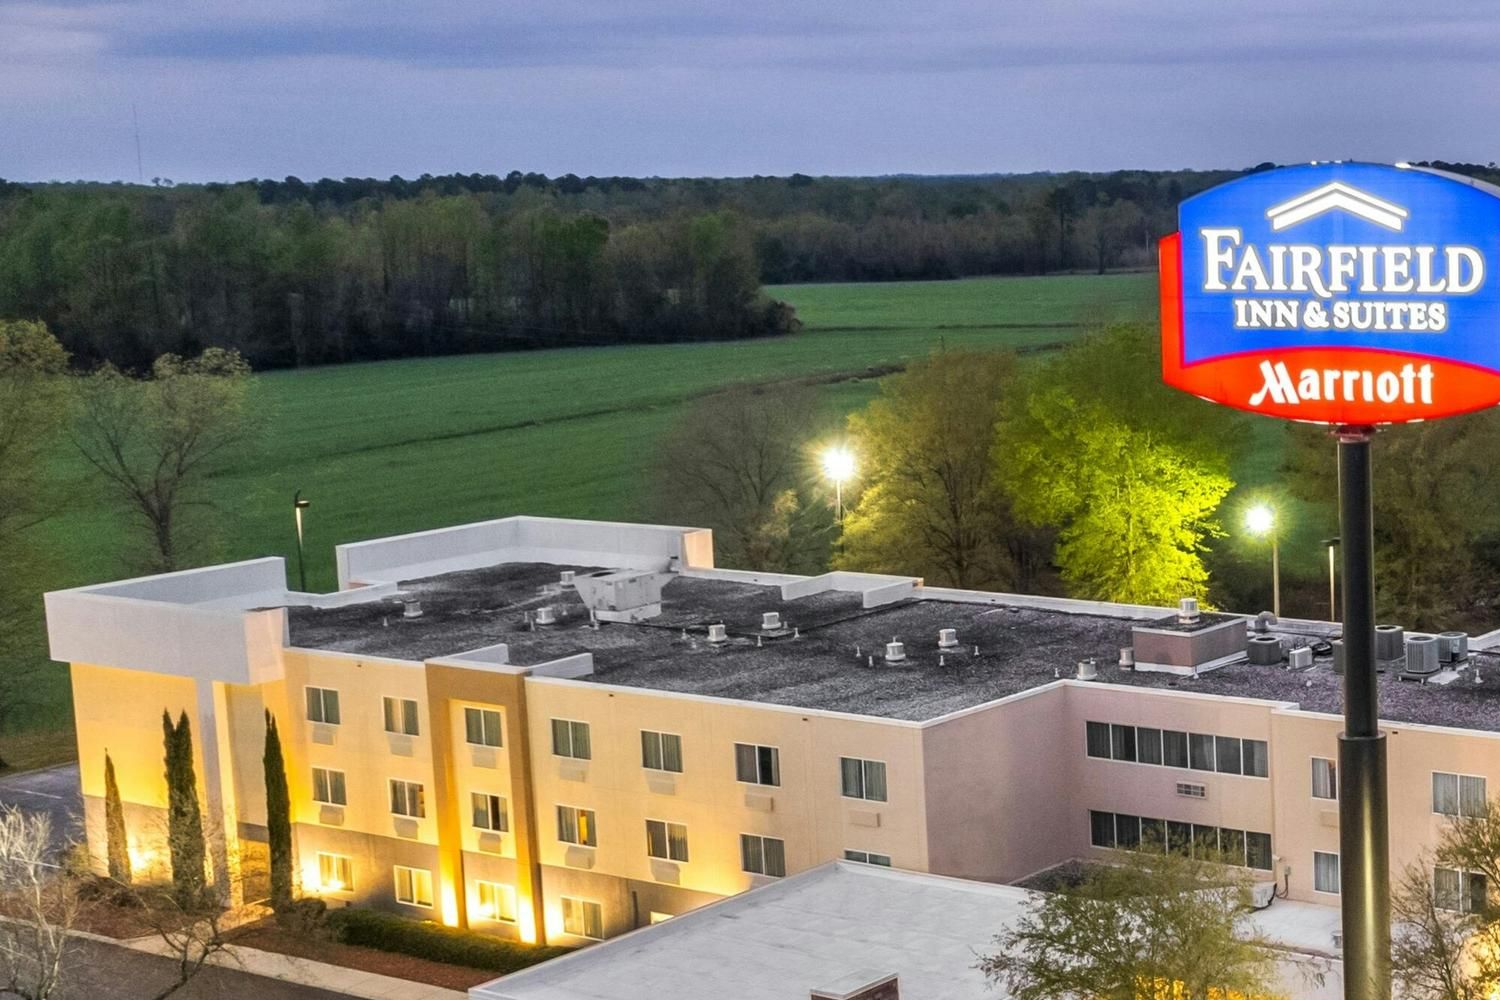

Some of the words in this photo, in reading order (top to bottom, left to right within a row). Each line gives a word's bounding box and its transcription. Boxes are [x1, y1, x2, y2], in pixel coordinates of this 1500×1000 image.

[1201, 229, 1484, 297] FAIRFIELD
[1236, 300, 1299, 328] INN
[1304, 301, 1330, 329] &
[1333, 302, 1446, 331] SUITES
[1249, 360, 1434, 405] Marriott
